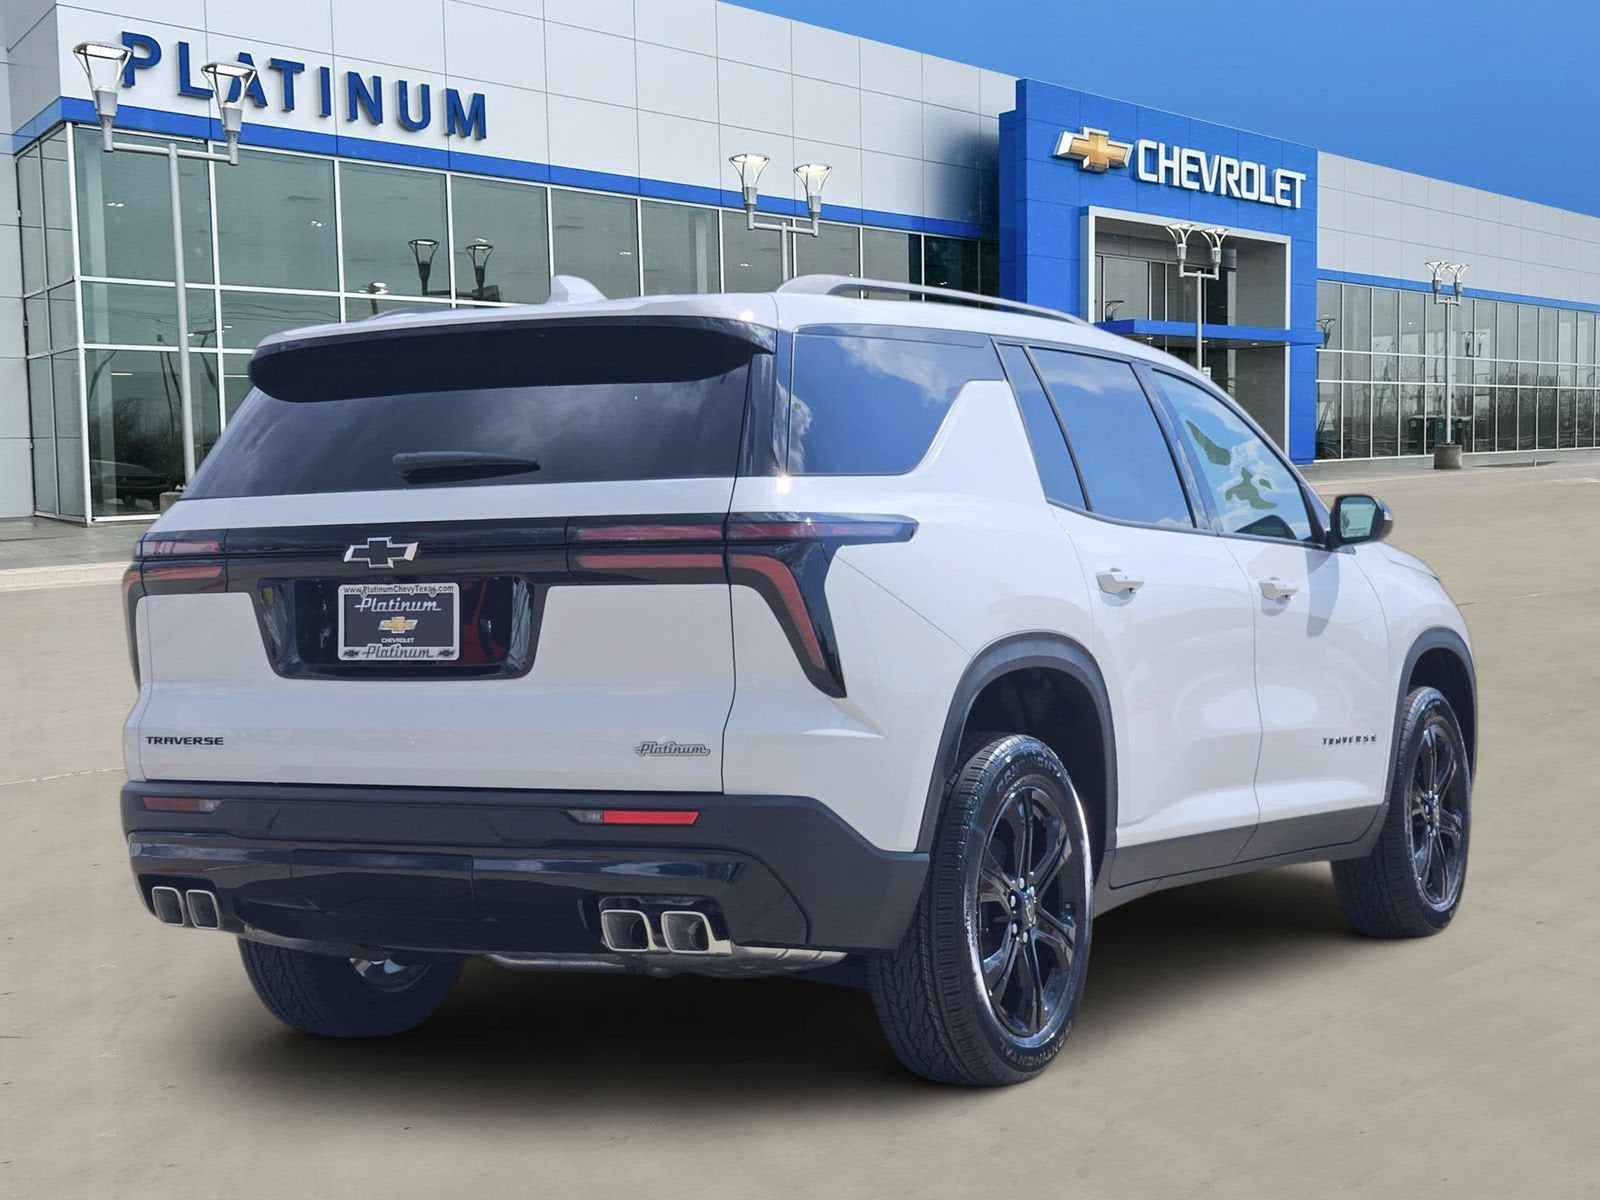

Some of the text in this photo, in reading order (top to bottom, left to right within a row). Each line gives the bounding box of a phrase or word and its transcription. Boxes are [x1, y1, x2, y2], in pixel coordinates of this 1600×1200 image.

[120, 31, 487, 141] PLATINUM
[1137, 138, 1306, 209] CHEVROLET
[343, 584, 454, 595] www.PlatinumChevyTexas.com
[354, 598, 442, 612] Platinum
[361, 644, 434, 658] Platinum
[146, 736, 224, 745] TRAVERSE
[1322, 734, 1376, 745] TRAVERSE
[634, 741, 711, 756] Platinum
